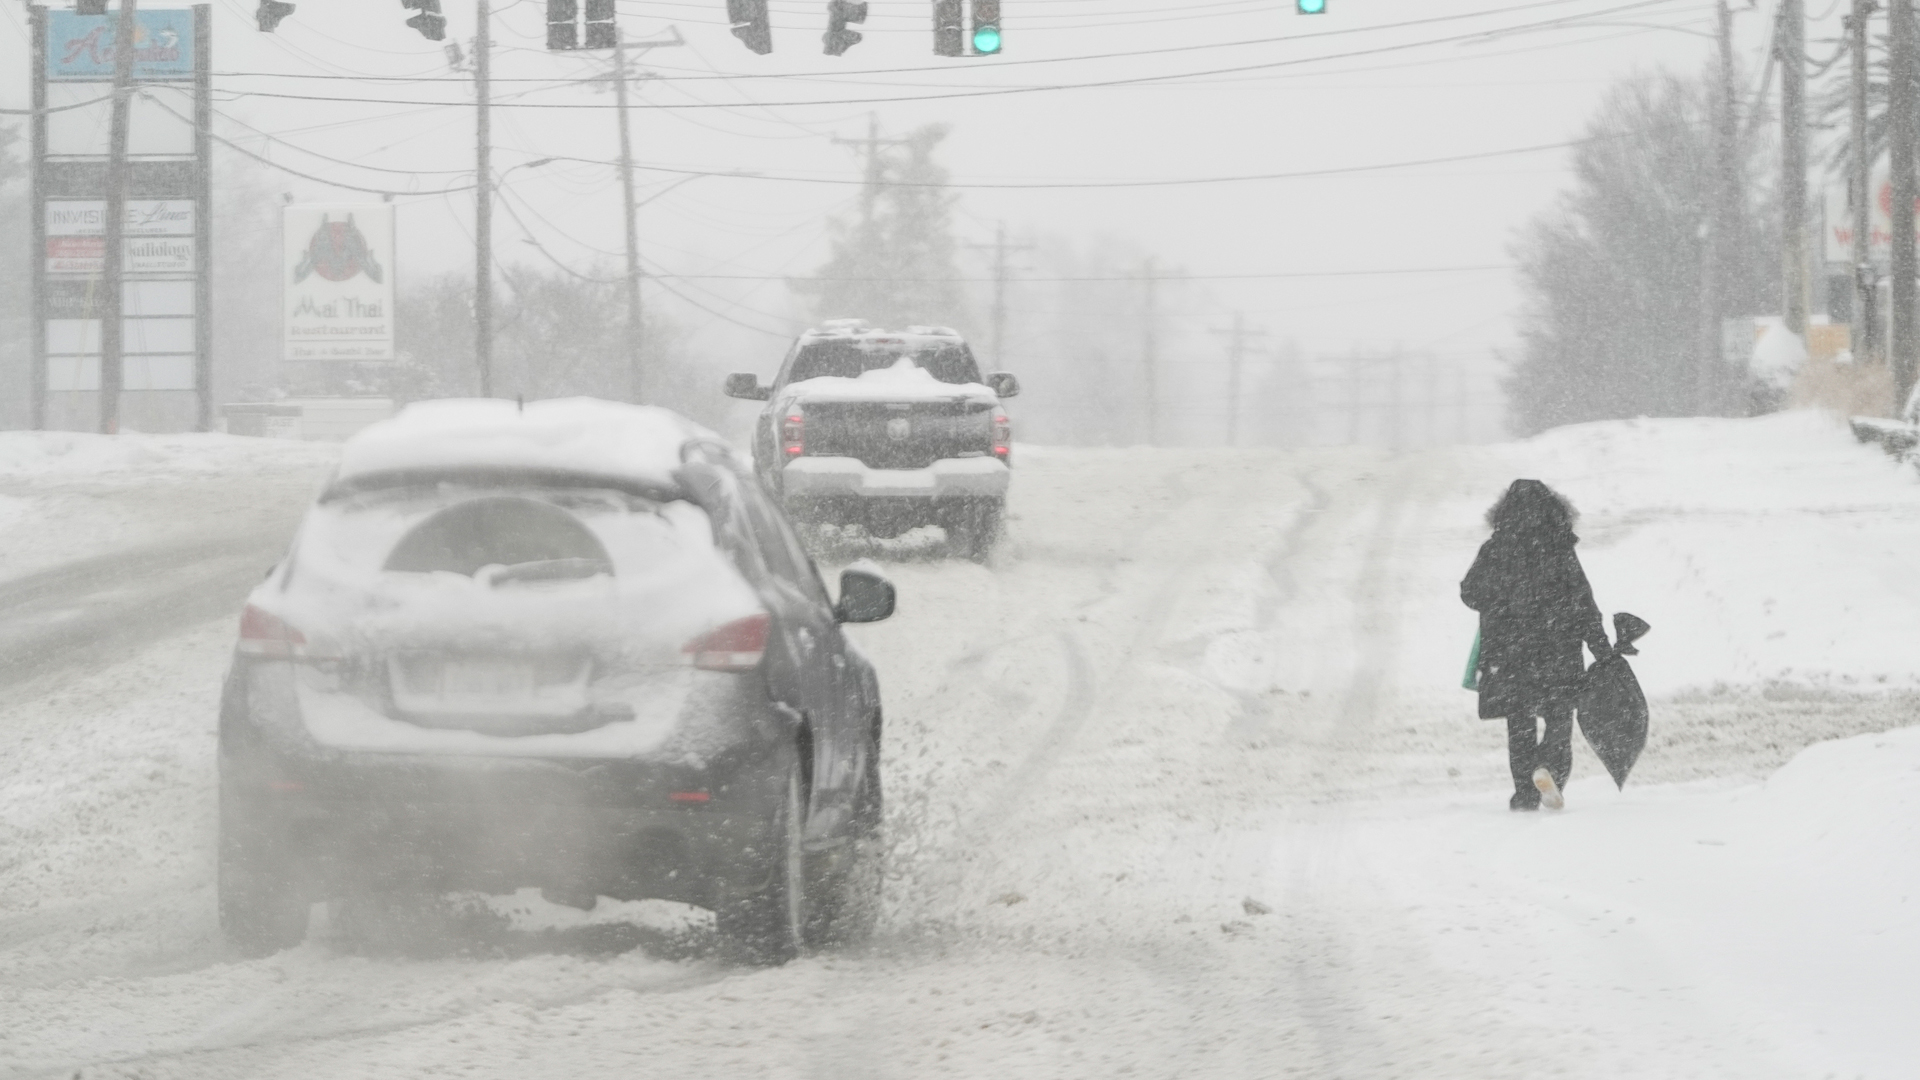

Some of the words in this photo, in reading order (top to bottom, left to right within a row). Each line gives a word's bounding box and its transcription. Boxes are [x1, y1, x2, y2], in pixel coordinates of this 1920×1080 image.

[48, 209, 138, 224] INVISIE
[292, 294, 339, 319] Mai
[341, 295, 384, 319] Thai
[290, 324, 386, 336] Restaurant
